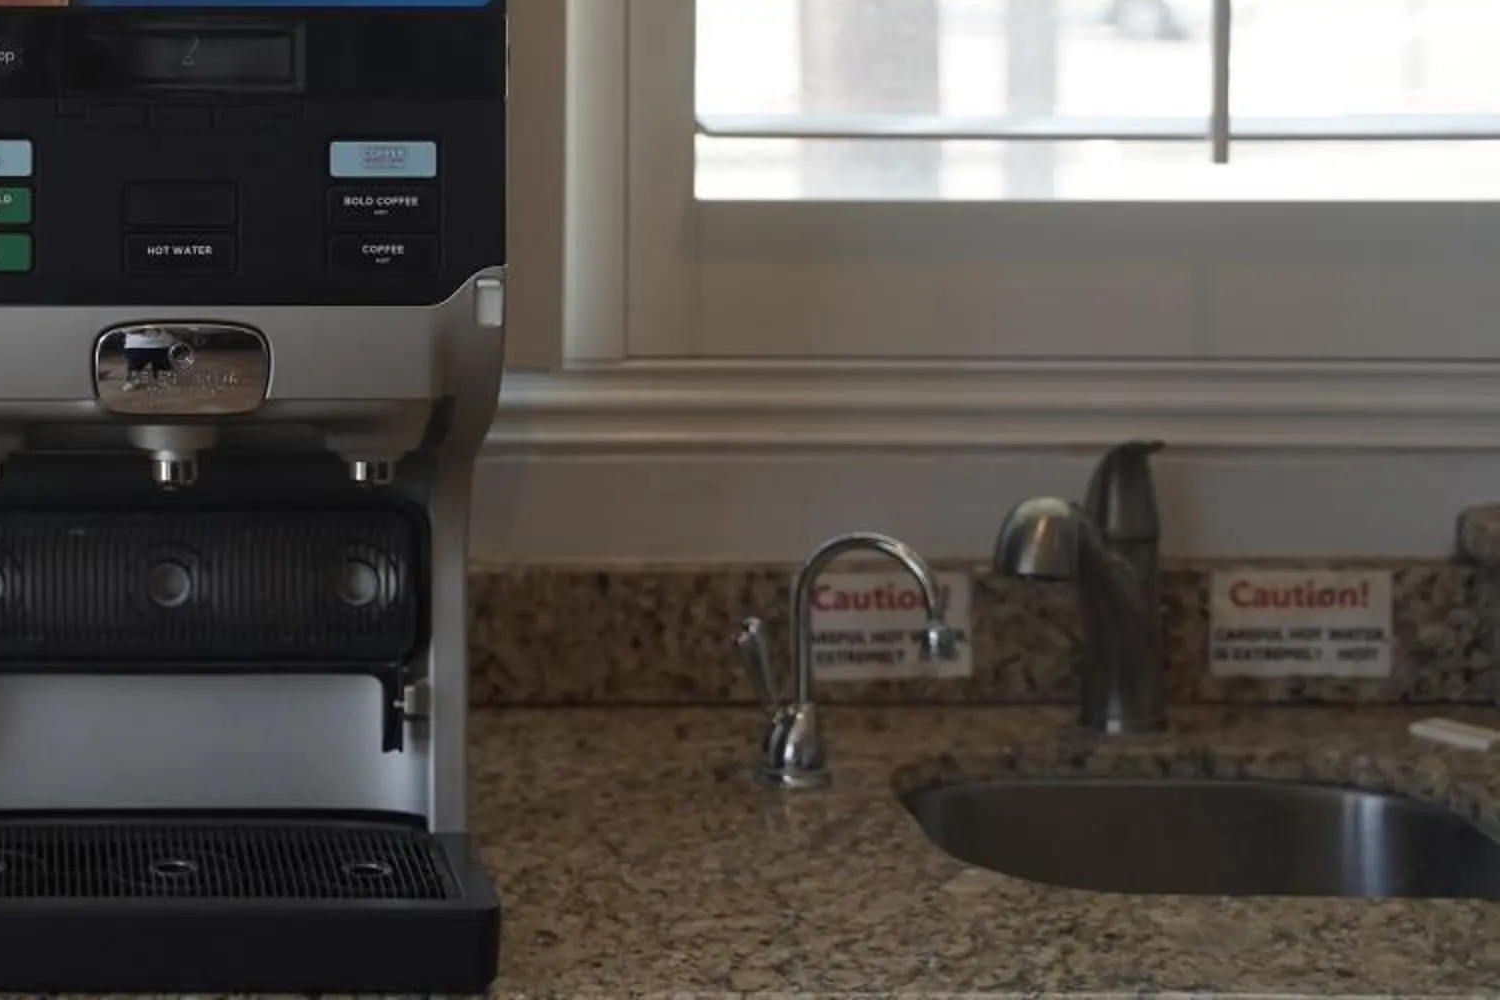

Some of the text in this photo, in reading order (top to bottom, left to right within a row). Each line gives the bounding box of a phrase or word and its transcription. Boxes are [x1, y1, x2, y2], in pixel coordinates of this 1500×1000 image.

[342, 195, 419, 206] BOLD COFFEE
[146, 244, 213, 255] HOT WATER
[360, 243, 405, 255] COFFEE
[1228, 579, 1370, 610] Caution!
